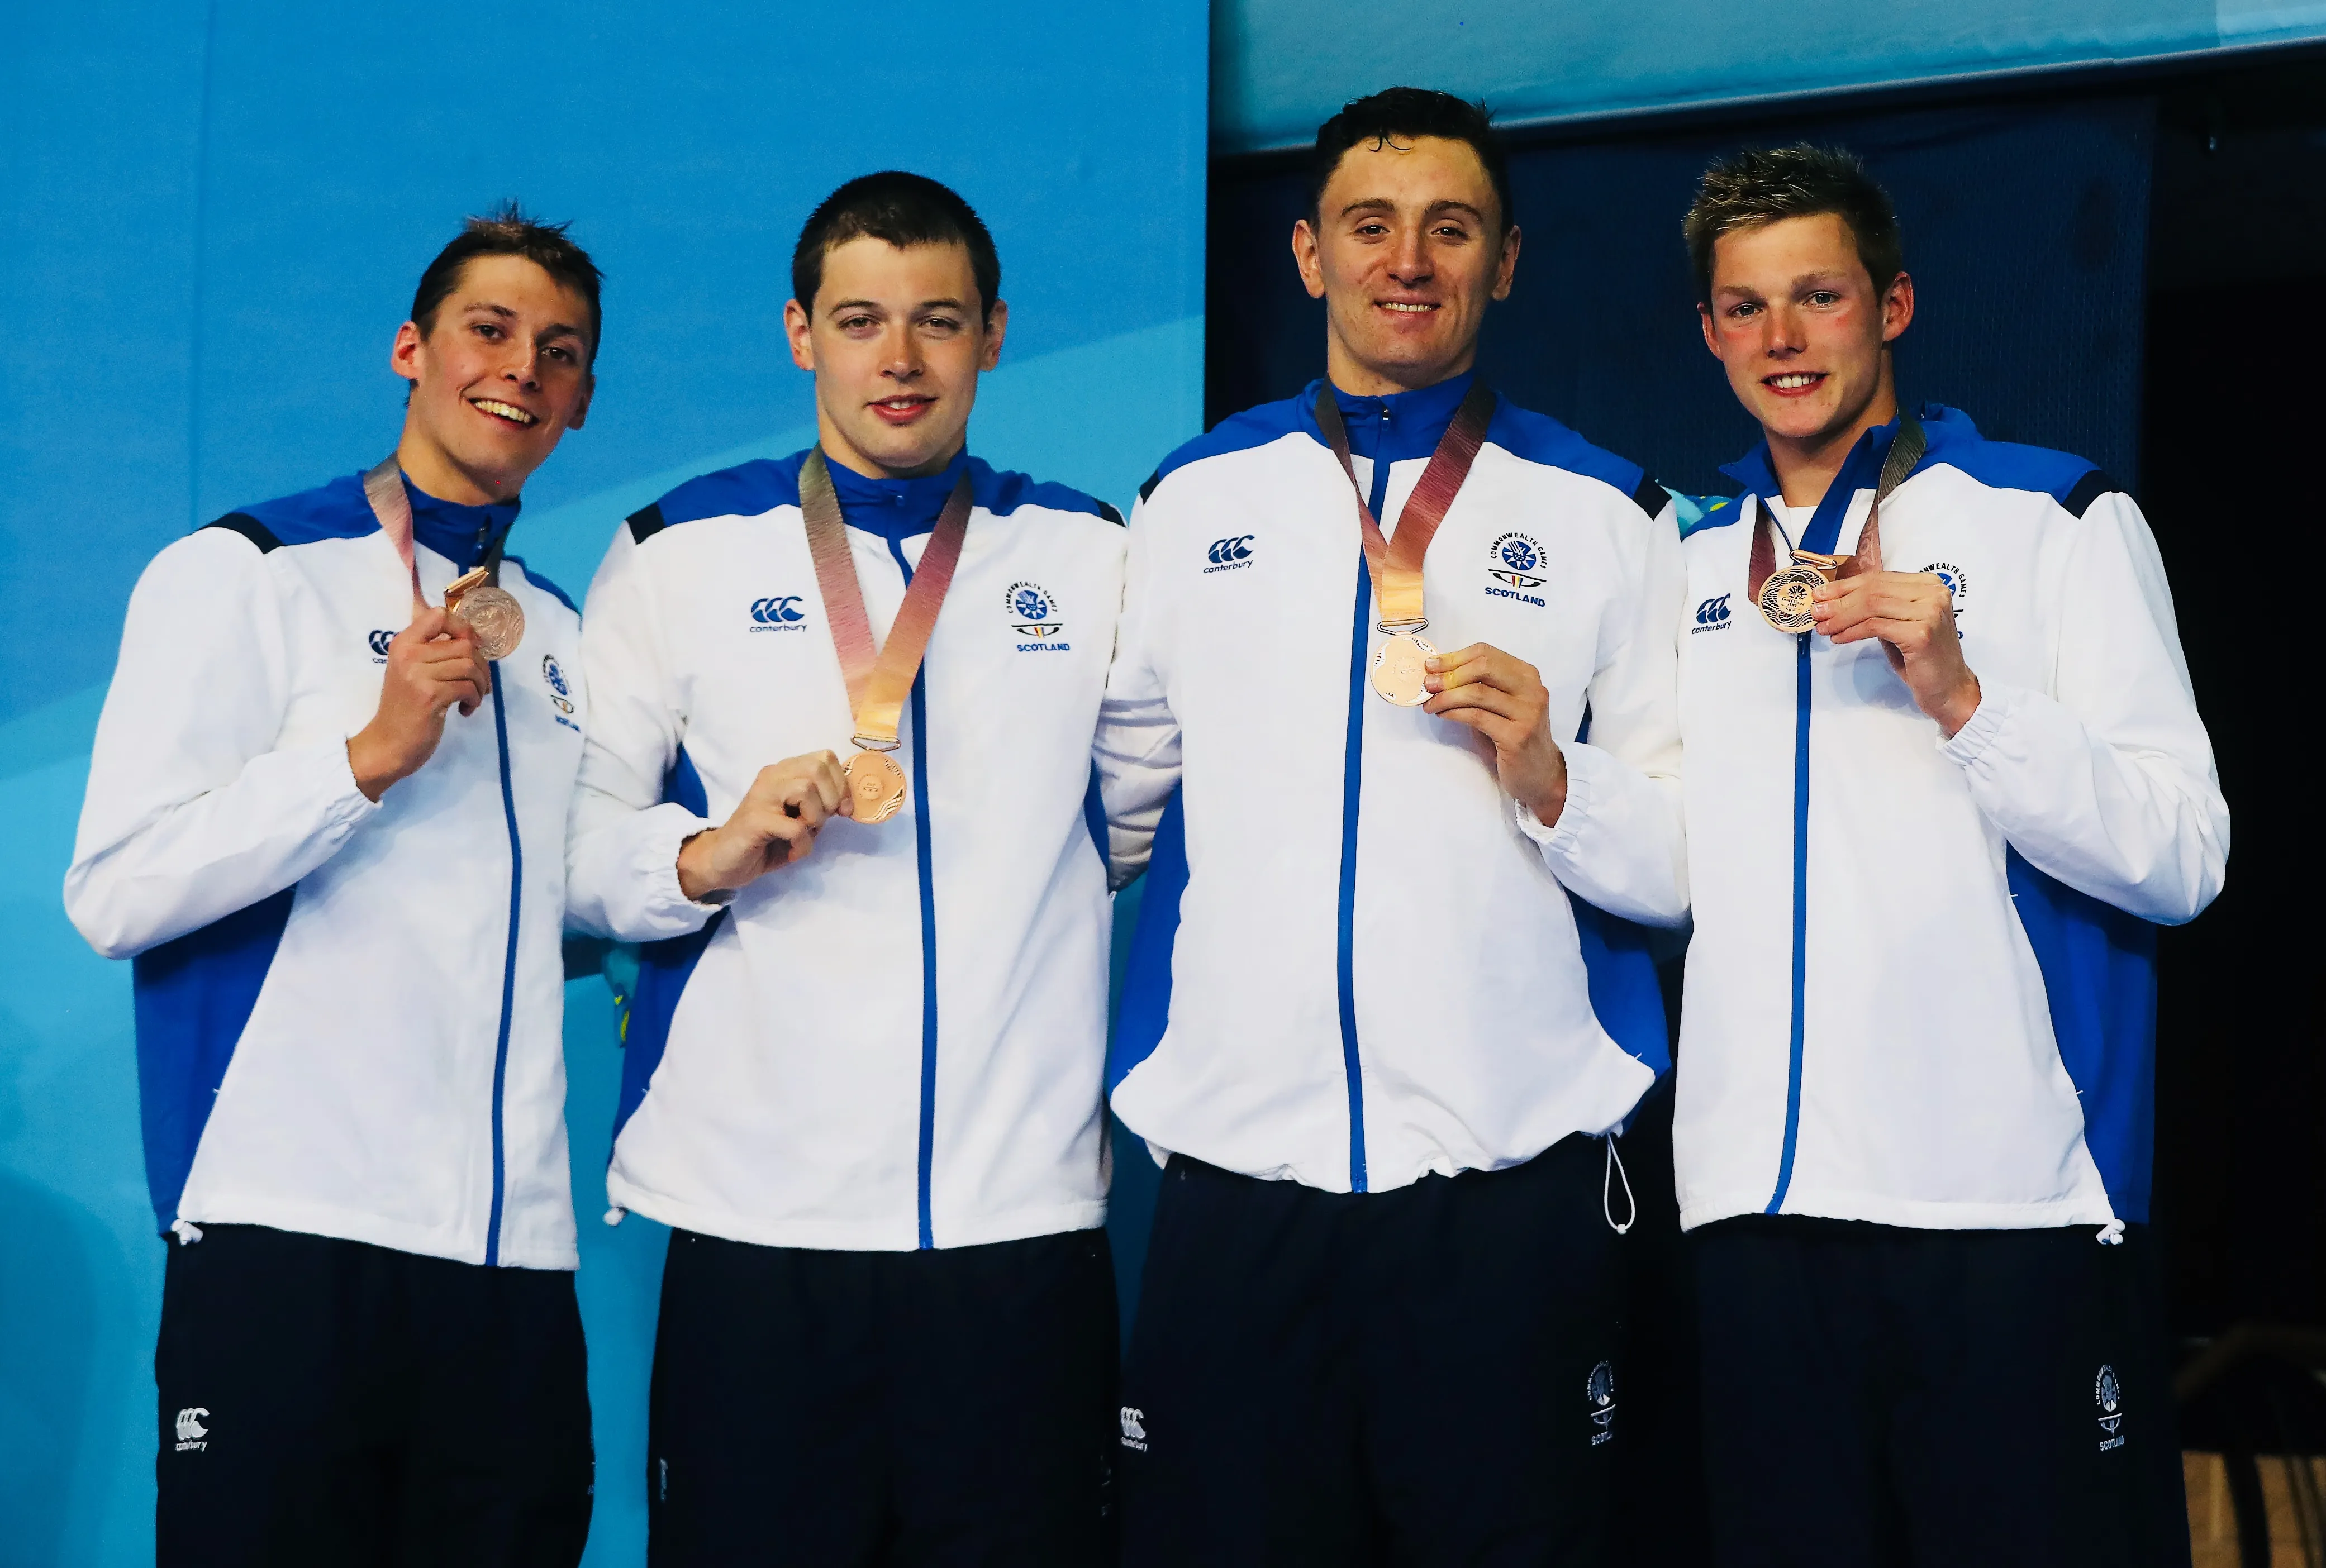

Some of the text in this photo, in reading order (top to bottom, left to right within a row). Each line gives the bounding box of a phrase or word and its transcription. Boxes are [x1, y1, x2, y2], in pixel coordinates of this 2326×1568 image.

[1491, 532, 1547, 569] COMMONWEALTH GAMES
[1203, 560, 1253, 574] canterbury
[1919, 563, 1967, 598] NWEALTH GAMES
[1485, 587, 1545, 607] SCOTLAND
[750, 623, 807, 633] canterbury
[1691, 621, 1732, 635] canterbury
[1016, 643, 1071, 652] SCOTLAND
